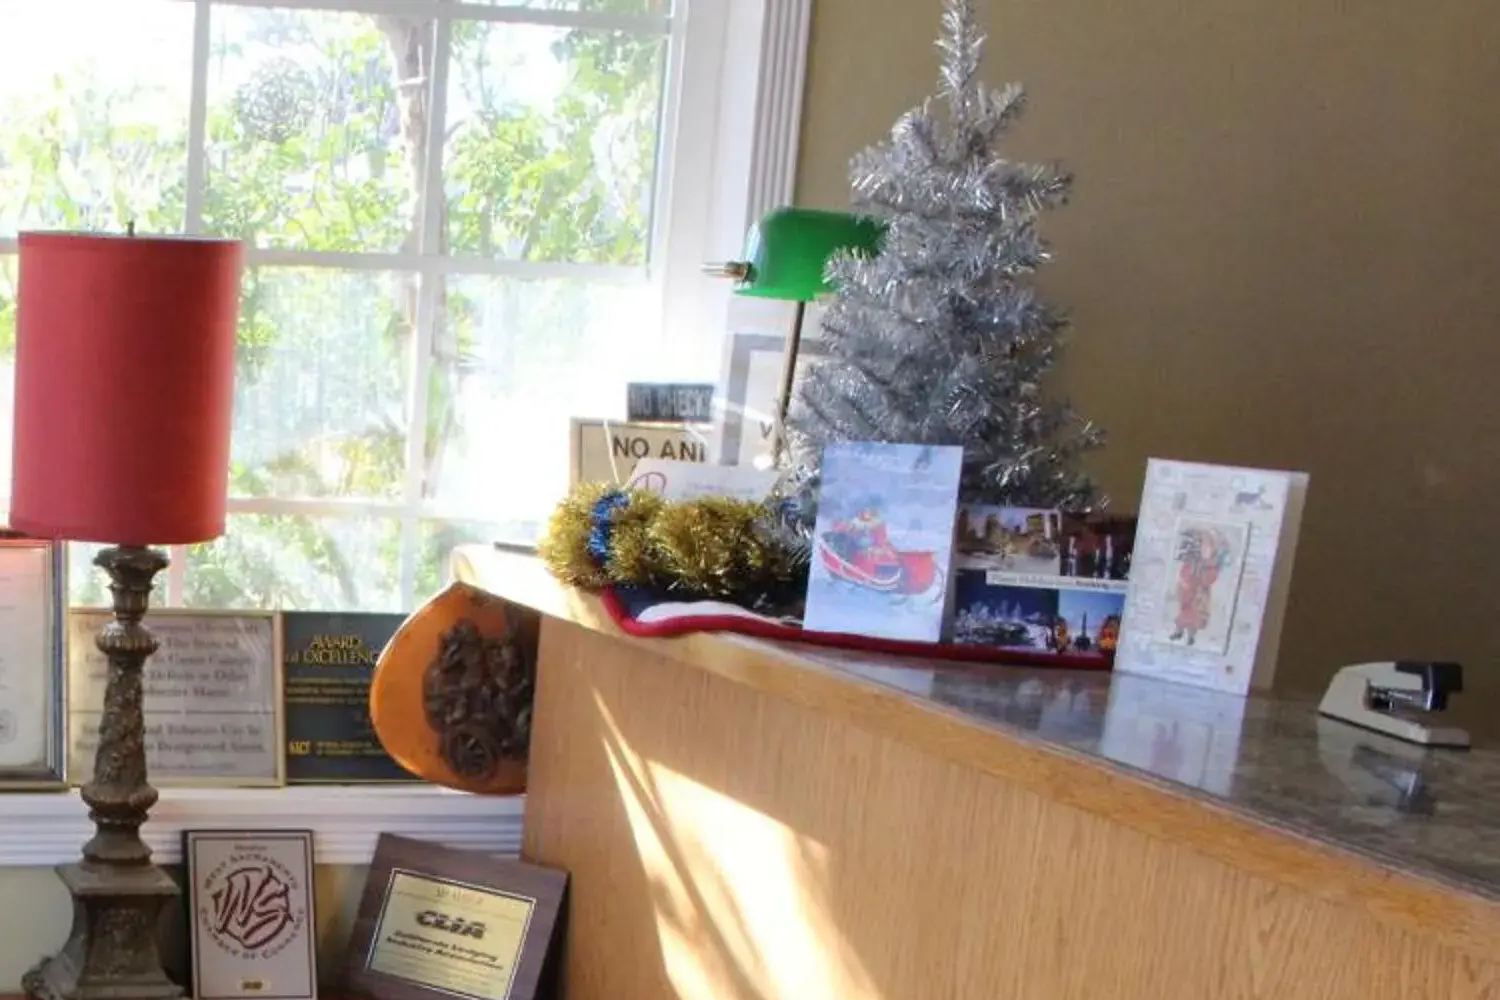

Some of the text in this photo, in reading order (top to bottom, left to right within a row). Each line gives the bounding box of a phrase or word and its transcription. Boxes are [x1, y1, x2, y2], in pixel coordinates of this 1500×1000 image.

[612, 435, 706, 462] NO ANI
[303, 649, 380, 665] EXCELLENC
